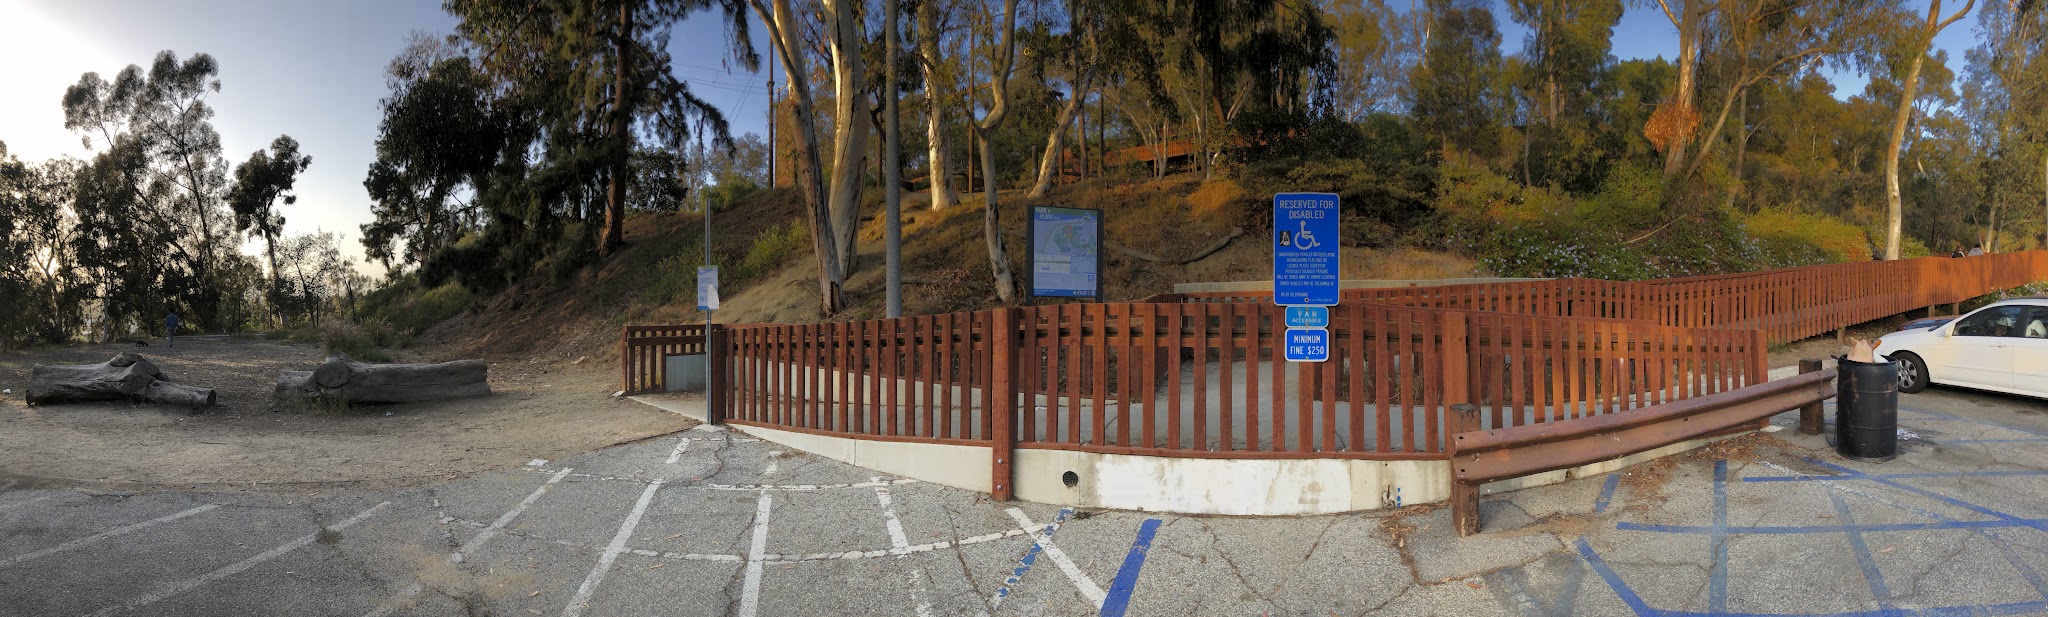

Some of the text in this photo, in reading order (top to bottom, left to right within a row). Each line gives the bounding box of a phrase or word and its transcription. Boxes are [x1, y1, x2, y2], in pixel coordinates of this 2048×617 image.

[1280, 200, 1334, 209] RESERVED FOR
[1289, 210, 1324, 219] DISABLED
[1294, 335, 1320, 343] MINIMUM
[1290, 346, 1324, 355] FINE $250
